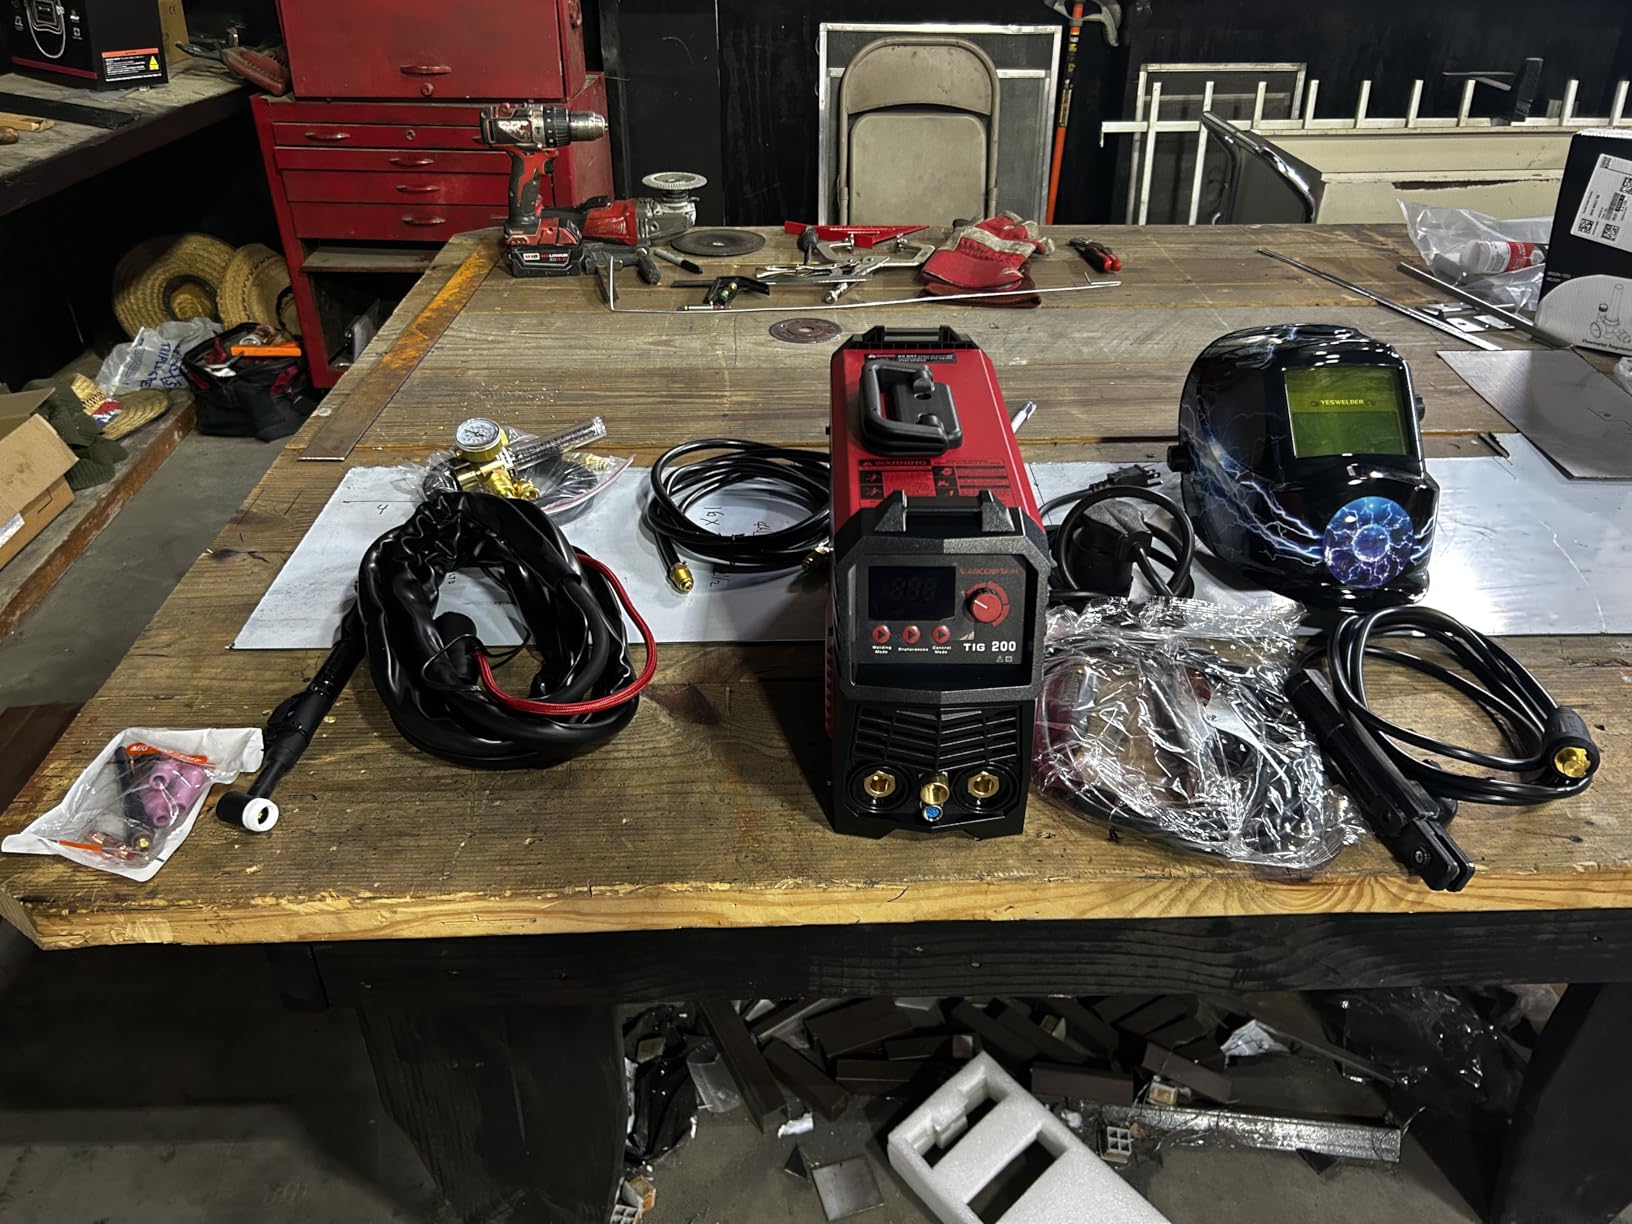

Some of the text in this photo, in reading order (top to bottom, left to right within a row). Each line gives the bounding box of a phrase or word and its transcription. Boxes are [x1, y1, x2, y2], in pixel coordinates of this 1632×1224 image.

[377, 504, 389, 515] 4
[963, 641, 1016, 652] TIG 200
